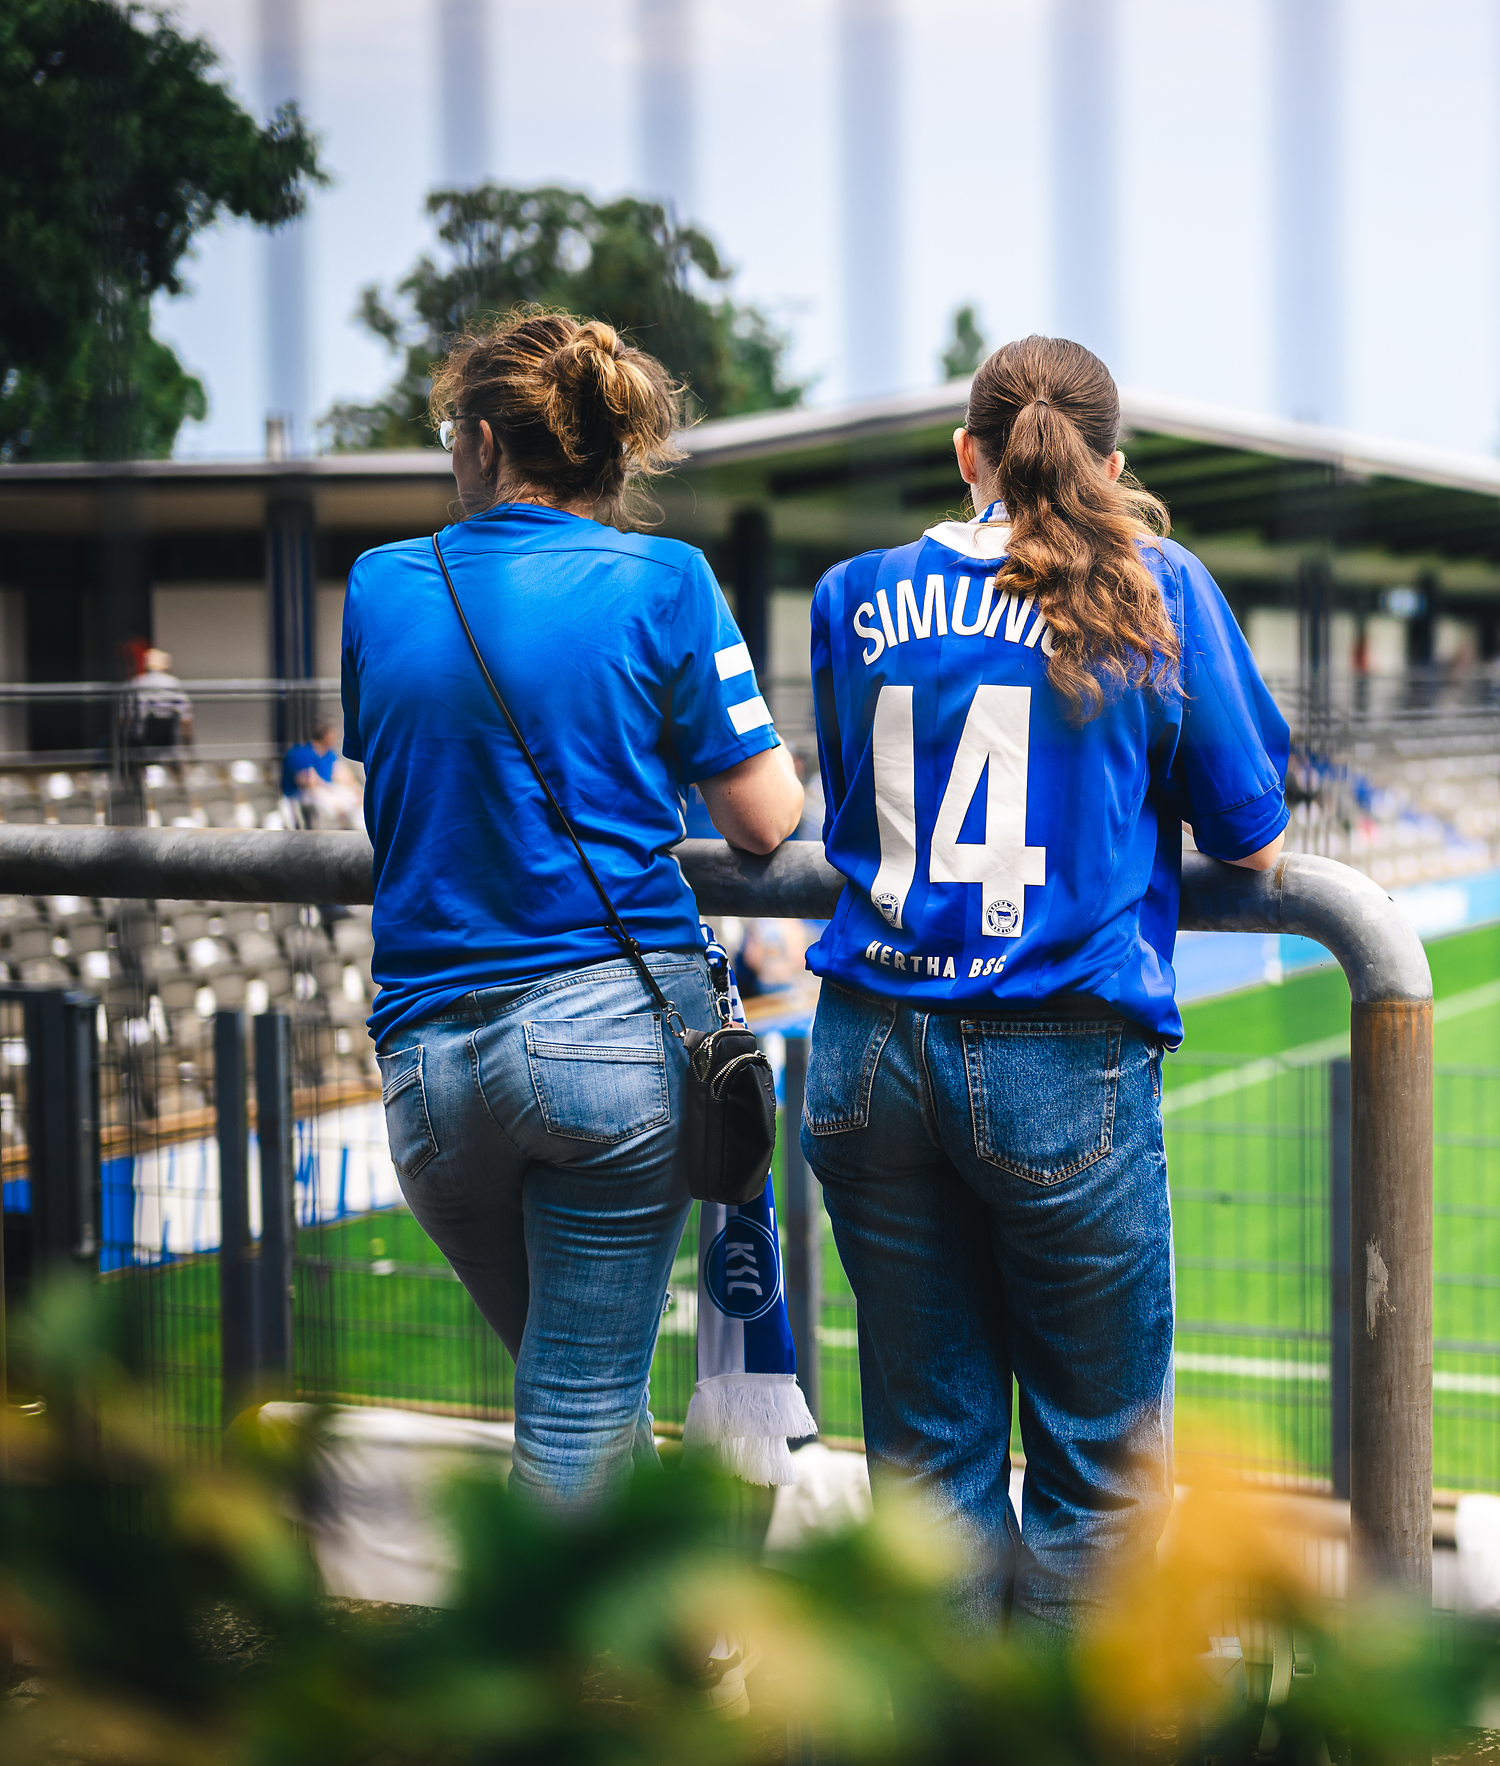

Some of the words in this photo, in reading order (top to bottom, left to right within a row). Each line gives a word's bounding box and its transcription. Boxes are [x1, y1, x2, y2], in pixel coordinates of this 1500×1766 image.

[870, 685, 1046, 938] 14
[865, 940, 956, 979] HERTHA
[968, 955, 1007, 978] BSC
[726, 1242, 763, 1296] KSC
